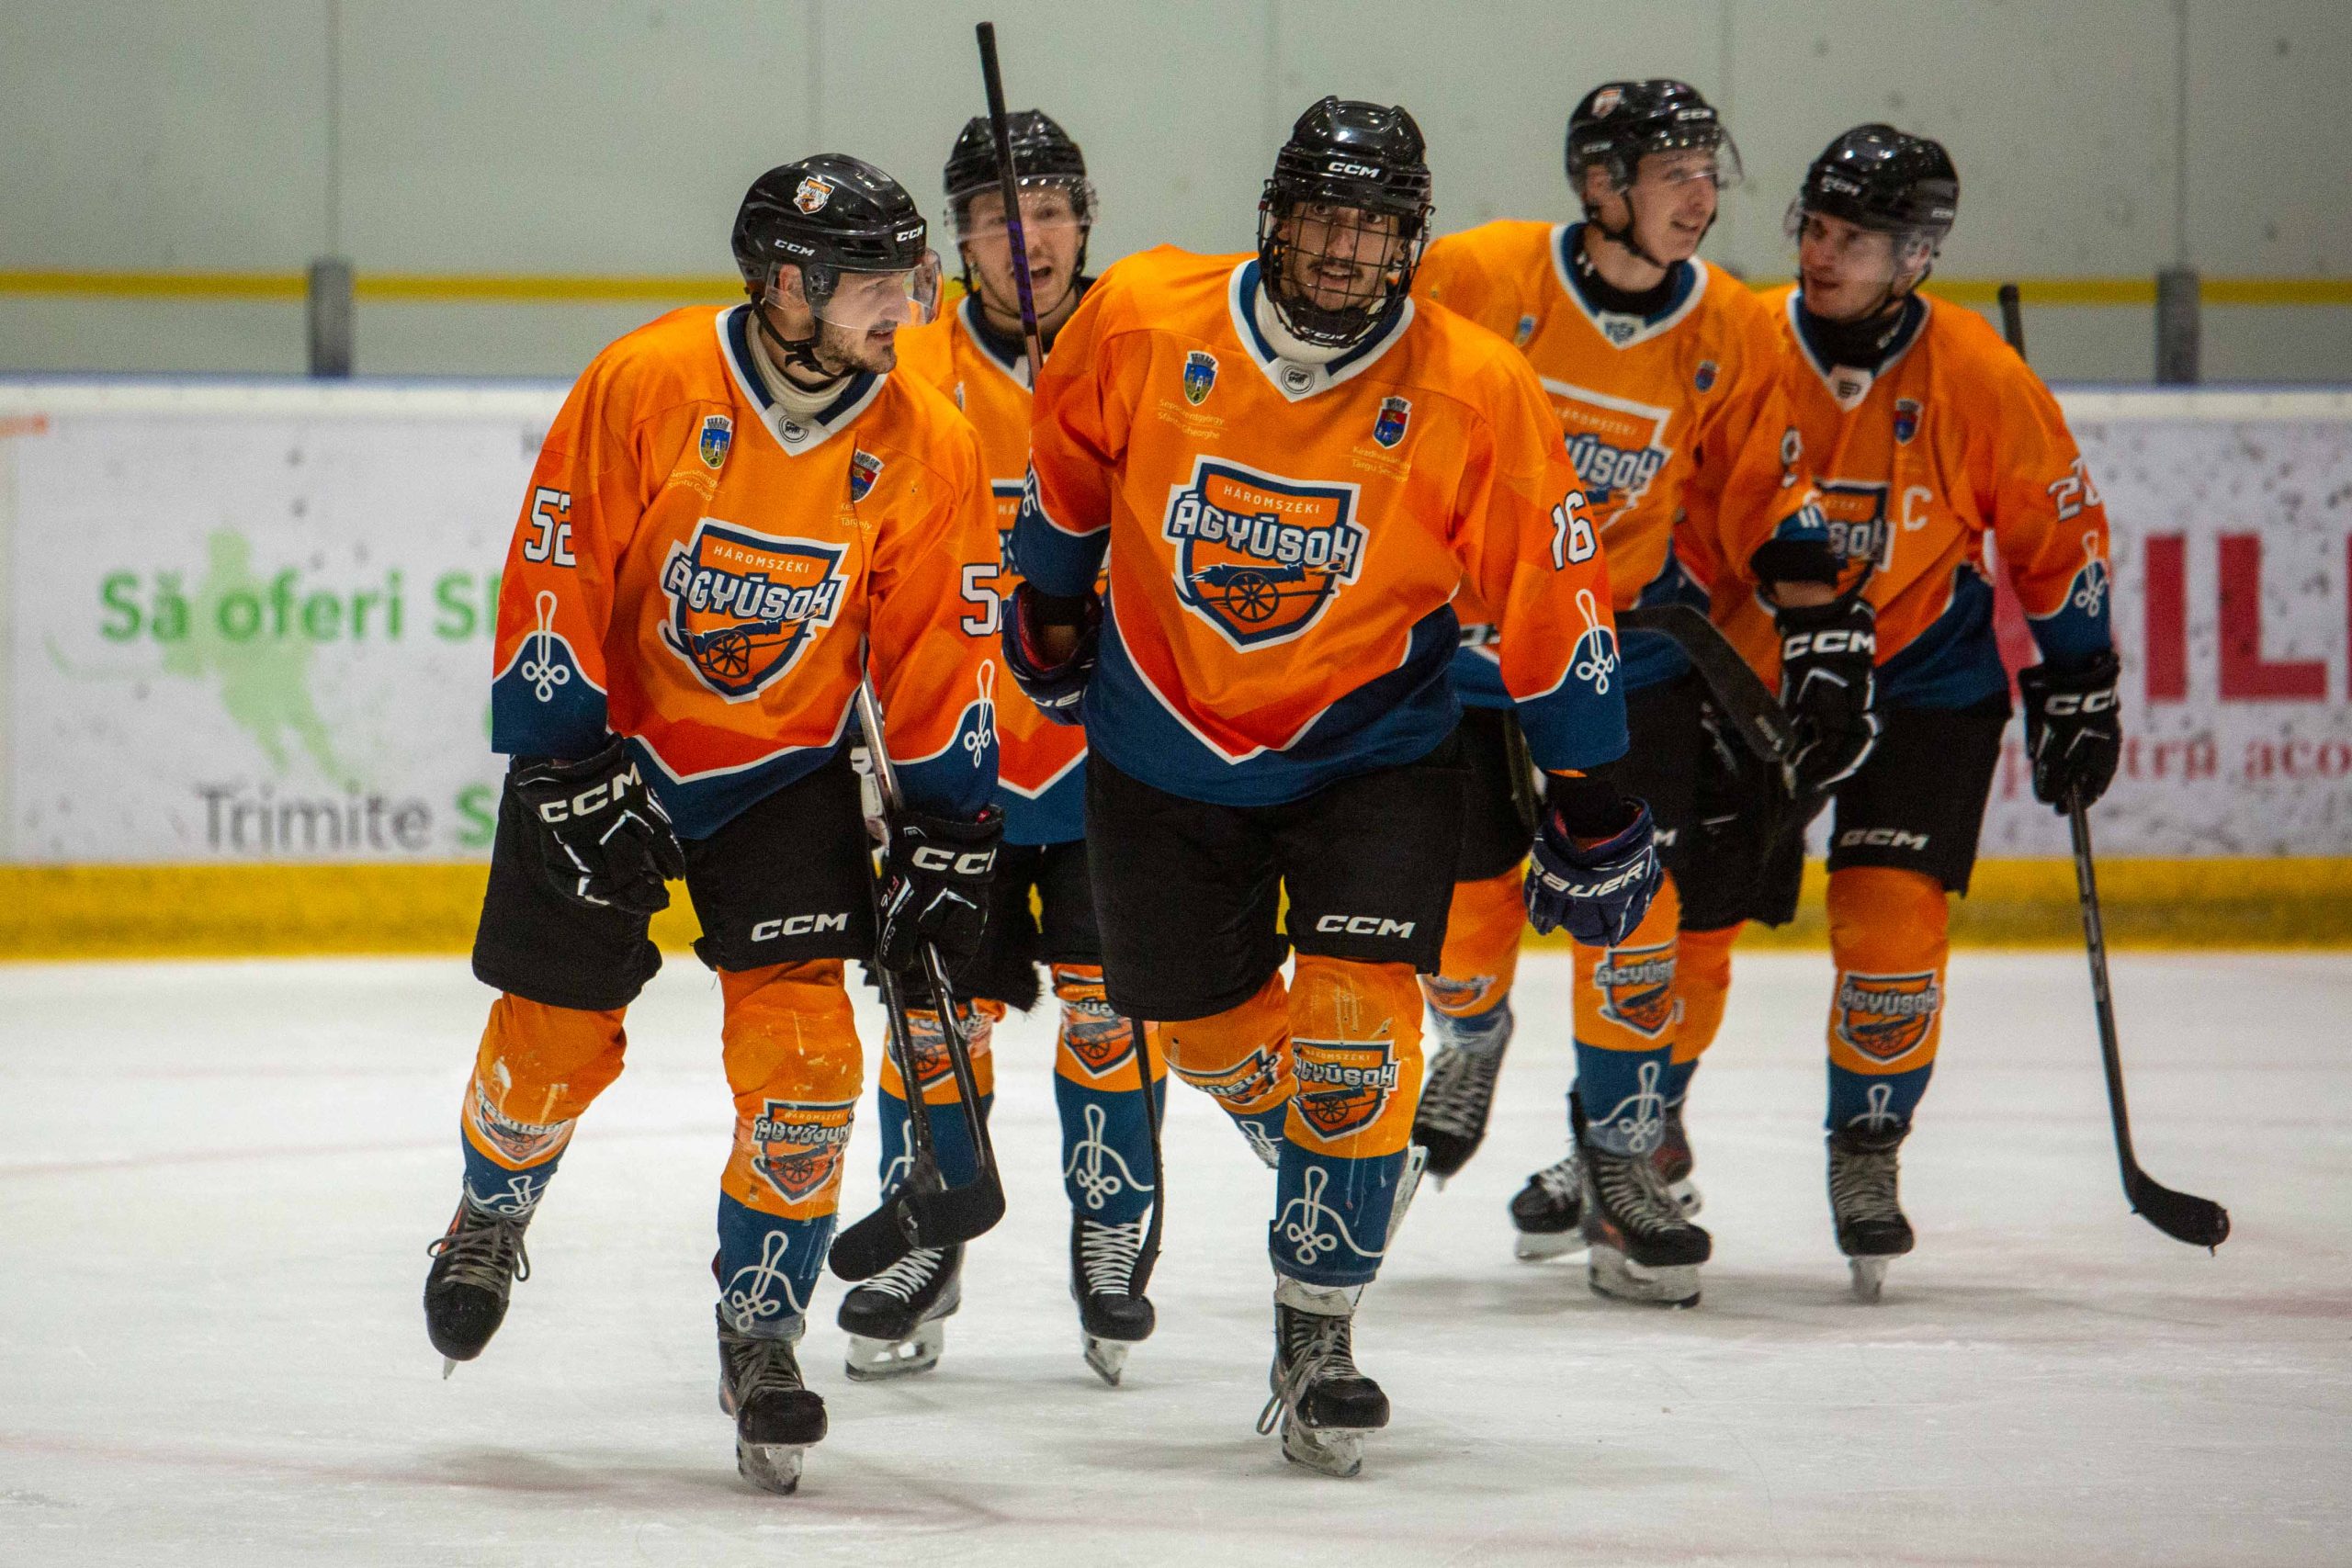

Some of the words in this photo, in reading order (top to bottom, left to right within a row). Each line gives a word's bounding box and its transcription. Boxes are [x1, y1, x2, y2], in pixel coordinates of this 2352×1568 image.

[1328, 162, 1380, 179] CCM
[774, 238, 816, 256] CCM
[1223, 484, 1321, 514] HÁROMSZÉKI
[1902, 486, 1933, 531] C
[523, 486, 577, 568] 52
[1550, 489, 1599, 571] 16
[713, 545, 810, 574] HÁROMSZÉKI
[214, 567, 404, 643] oferi
[960, 562, 1004, 637] 5
[1783, 629, 1877, 660] CCM
[2044, 689, 2117, 716] CC
[539, 762, 643, 823] CCM
[195, 779, 434, 852] Trimite
[911, 845, 998, 874] CC
[751, 913, 849, 942] CCM
[1316, 915, 1417, 940] CCM
